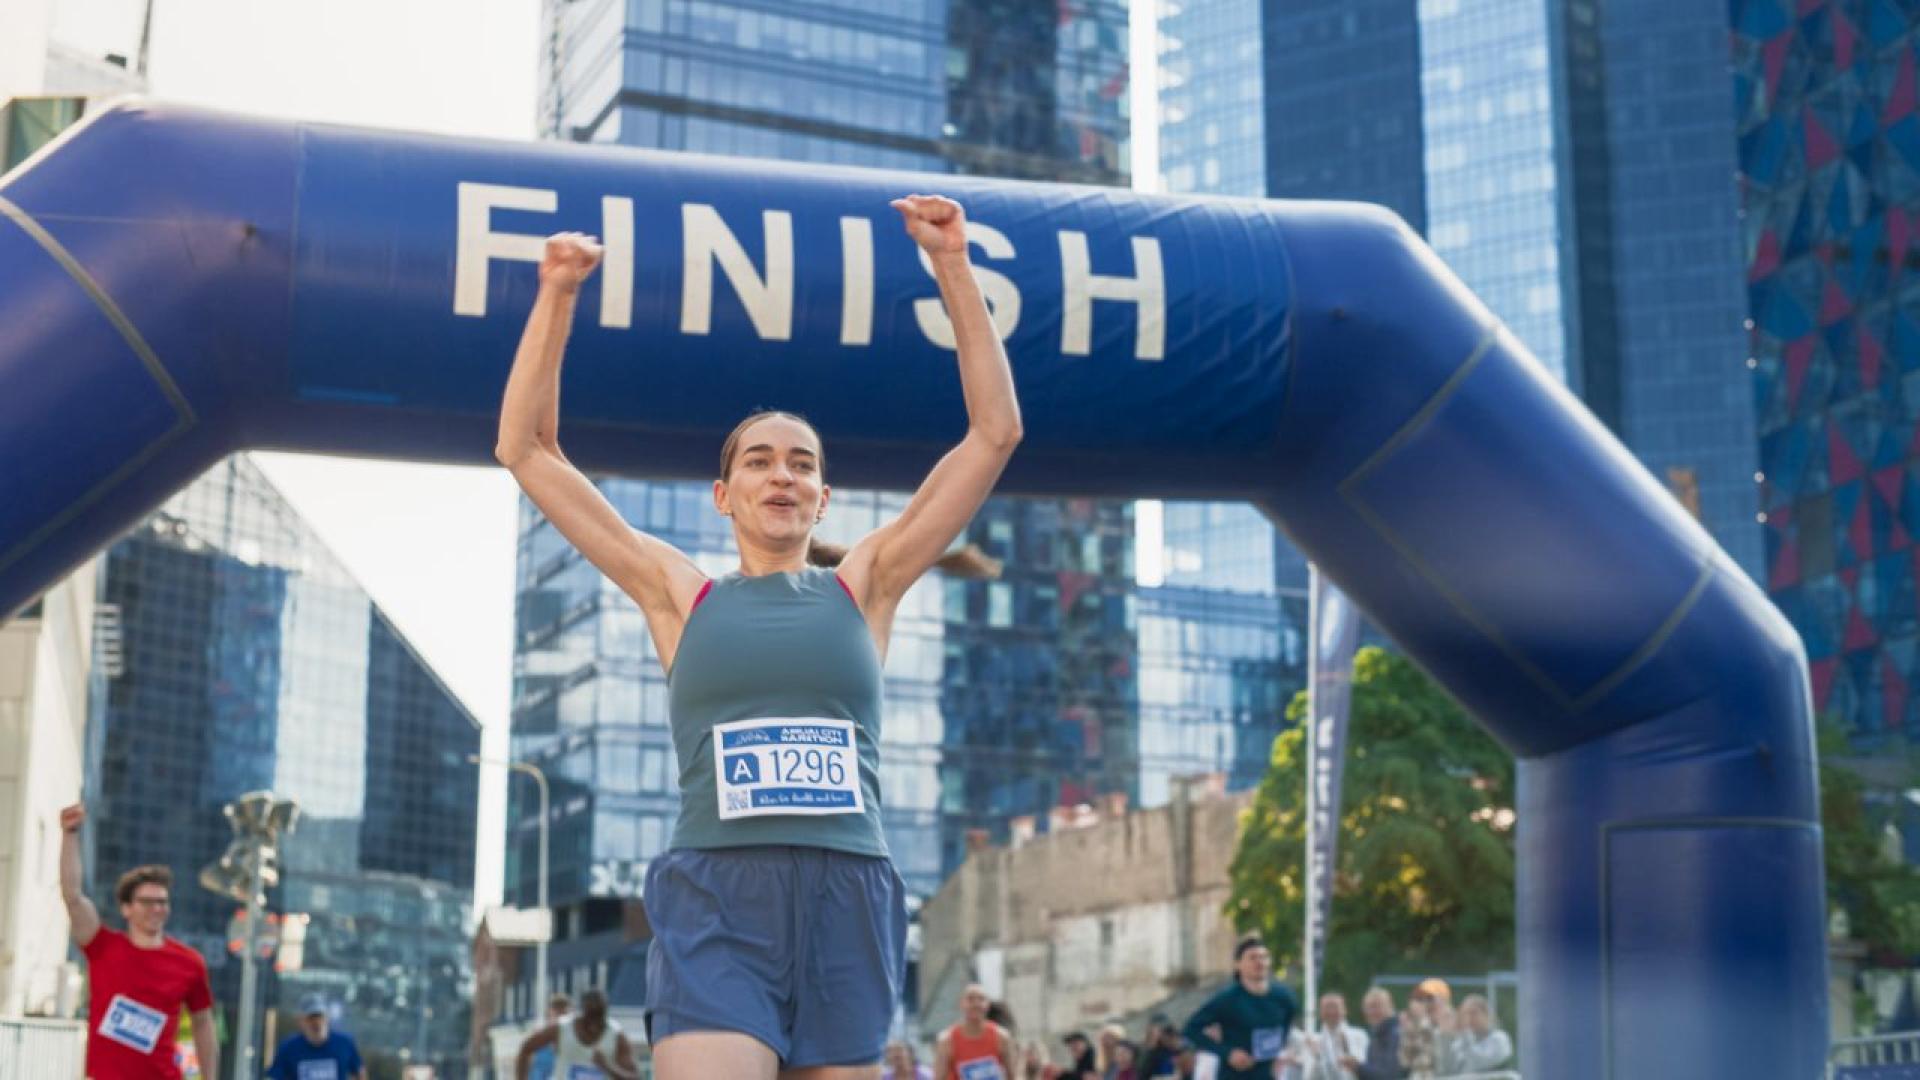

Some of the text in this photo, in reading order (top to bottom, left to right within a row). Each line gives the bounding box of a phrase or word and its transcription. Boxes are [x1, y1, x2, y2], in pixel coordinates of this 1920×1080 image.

[453, 182, 1166, 361] FINISH
[733, 749, 845, 785] A 1296
